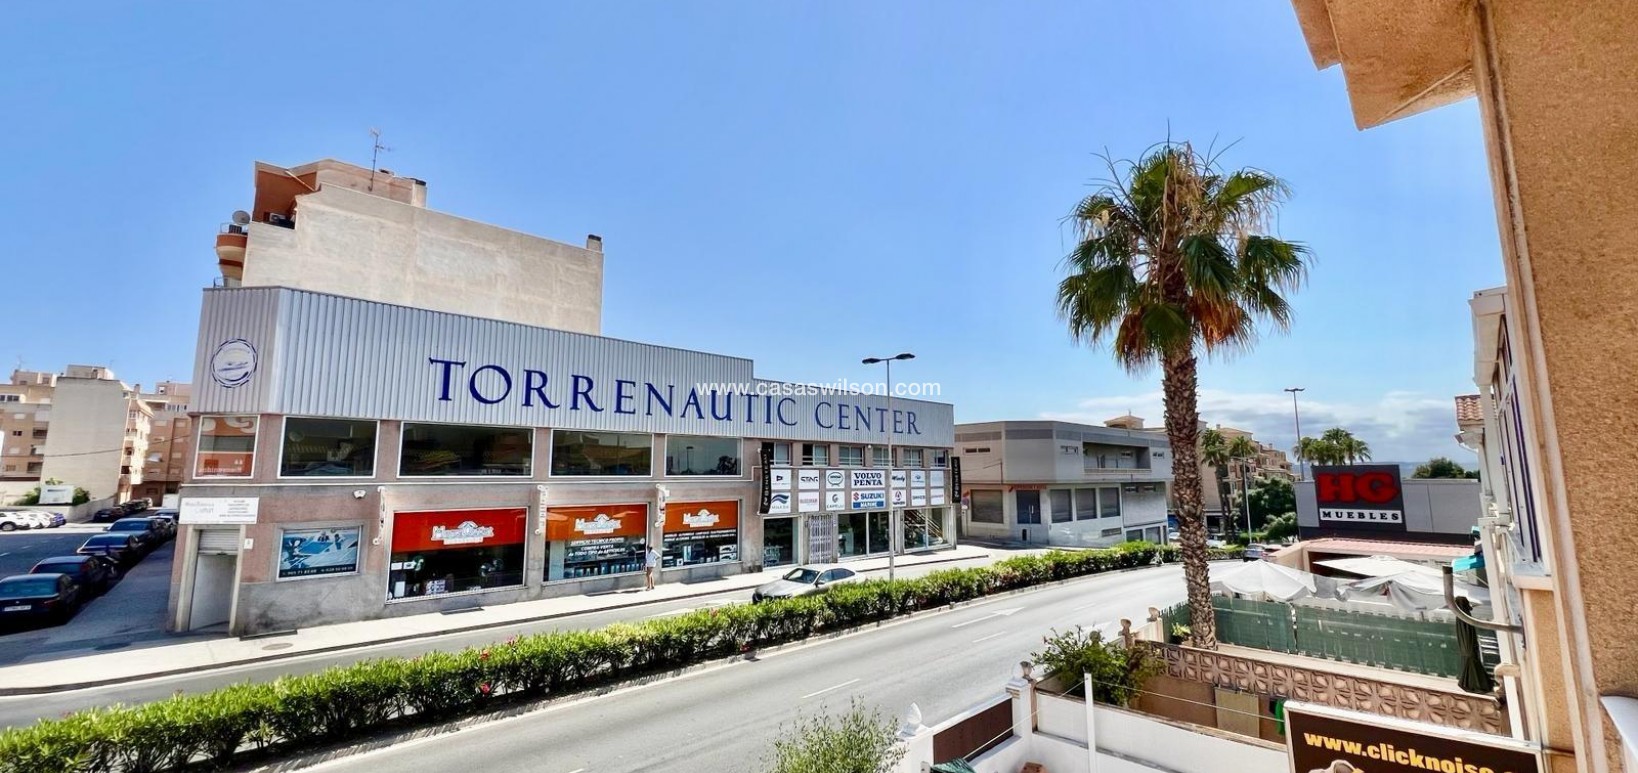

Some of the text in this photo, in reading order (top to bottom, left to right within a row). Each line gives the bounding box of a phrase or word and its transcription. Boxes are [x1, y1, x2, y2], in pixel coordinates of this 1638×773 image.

[428, 357, 922, 435] TORRENAUTIC CENTER
[1316, 471, 1399, 504] HG
[1322, 511, 1399, 521] MUEBLES
